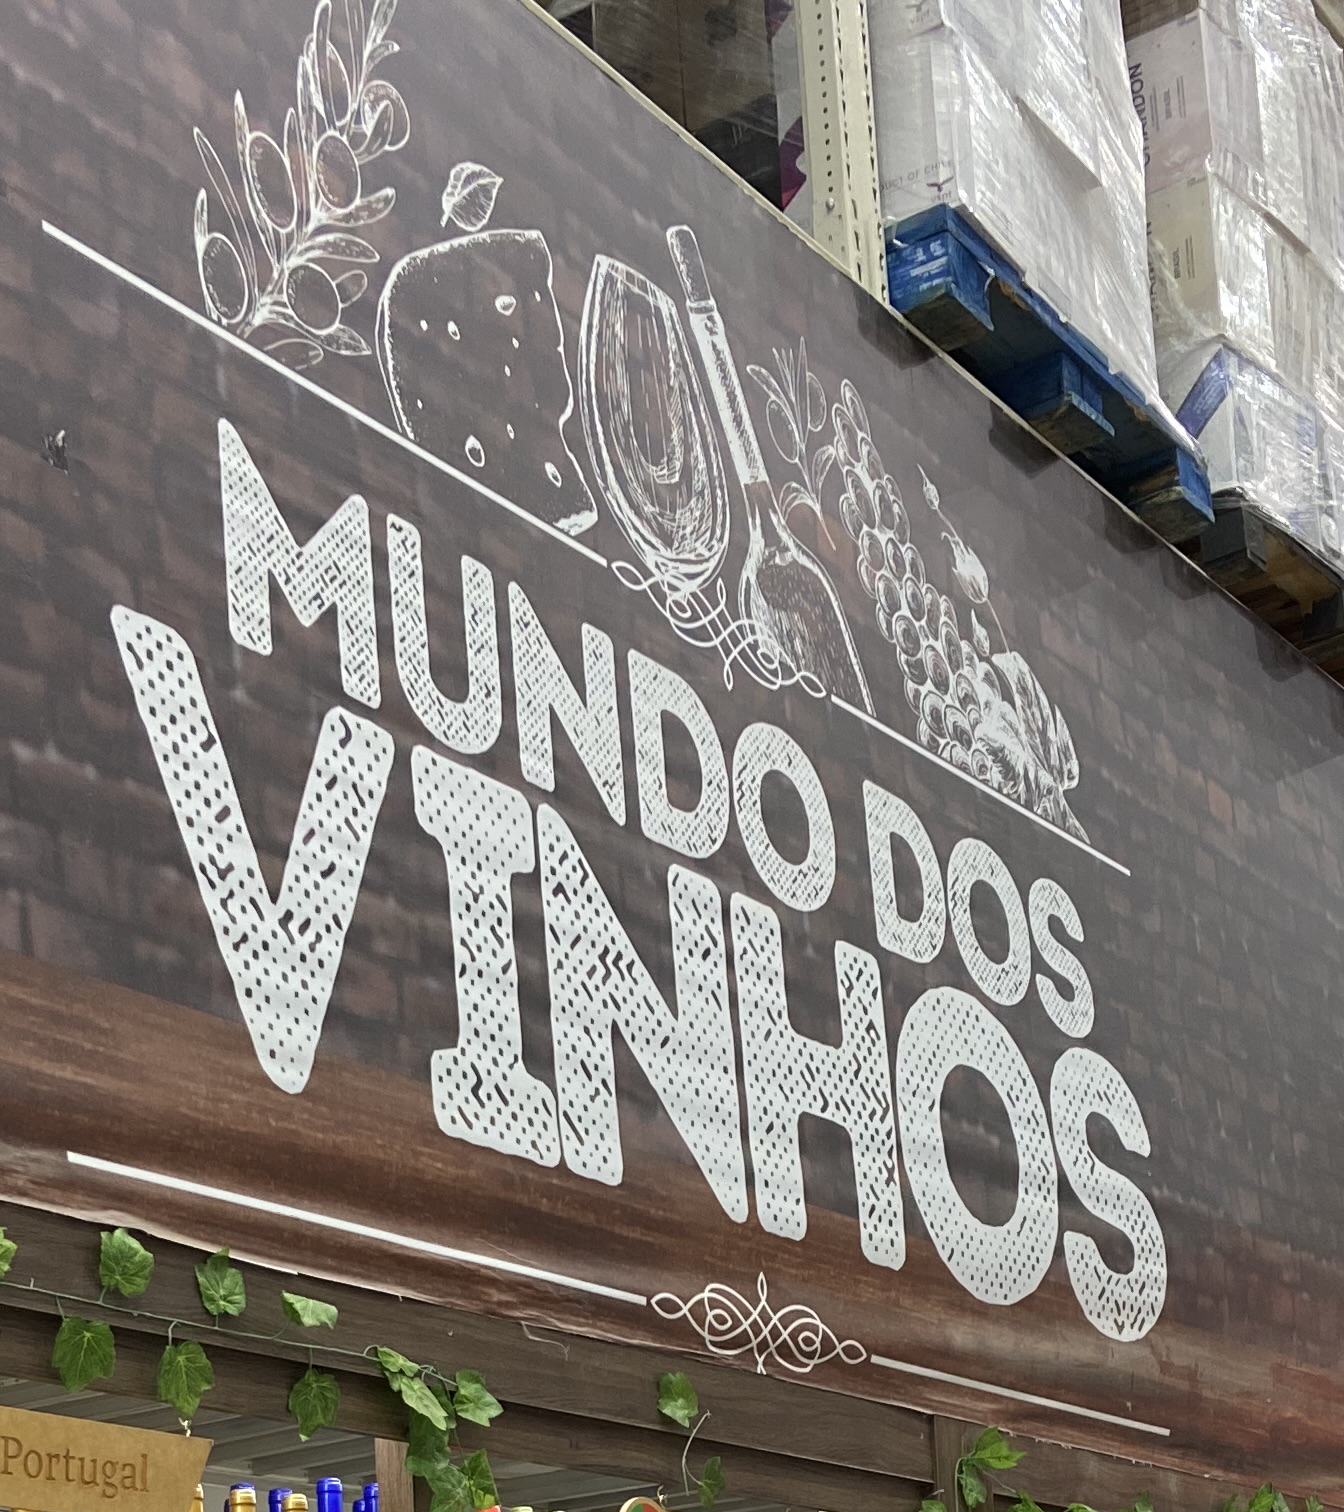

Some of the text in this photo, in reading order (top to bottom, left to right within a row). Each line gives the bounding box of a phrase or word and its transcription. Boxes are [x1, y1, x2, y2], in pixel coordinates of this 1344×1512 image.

[110, 604, 1168, 1341] VINHOS
[219, 418, 1095, 1038] MUNDO DOS
[2, 1434, 151, 1495] Portugal
